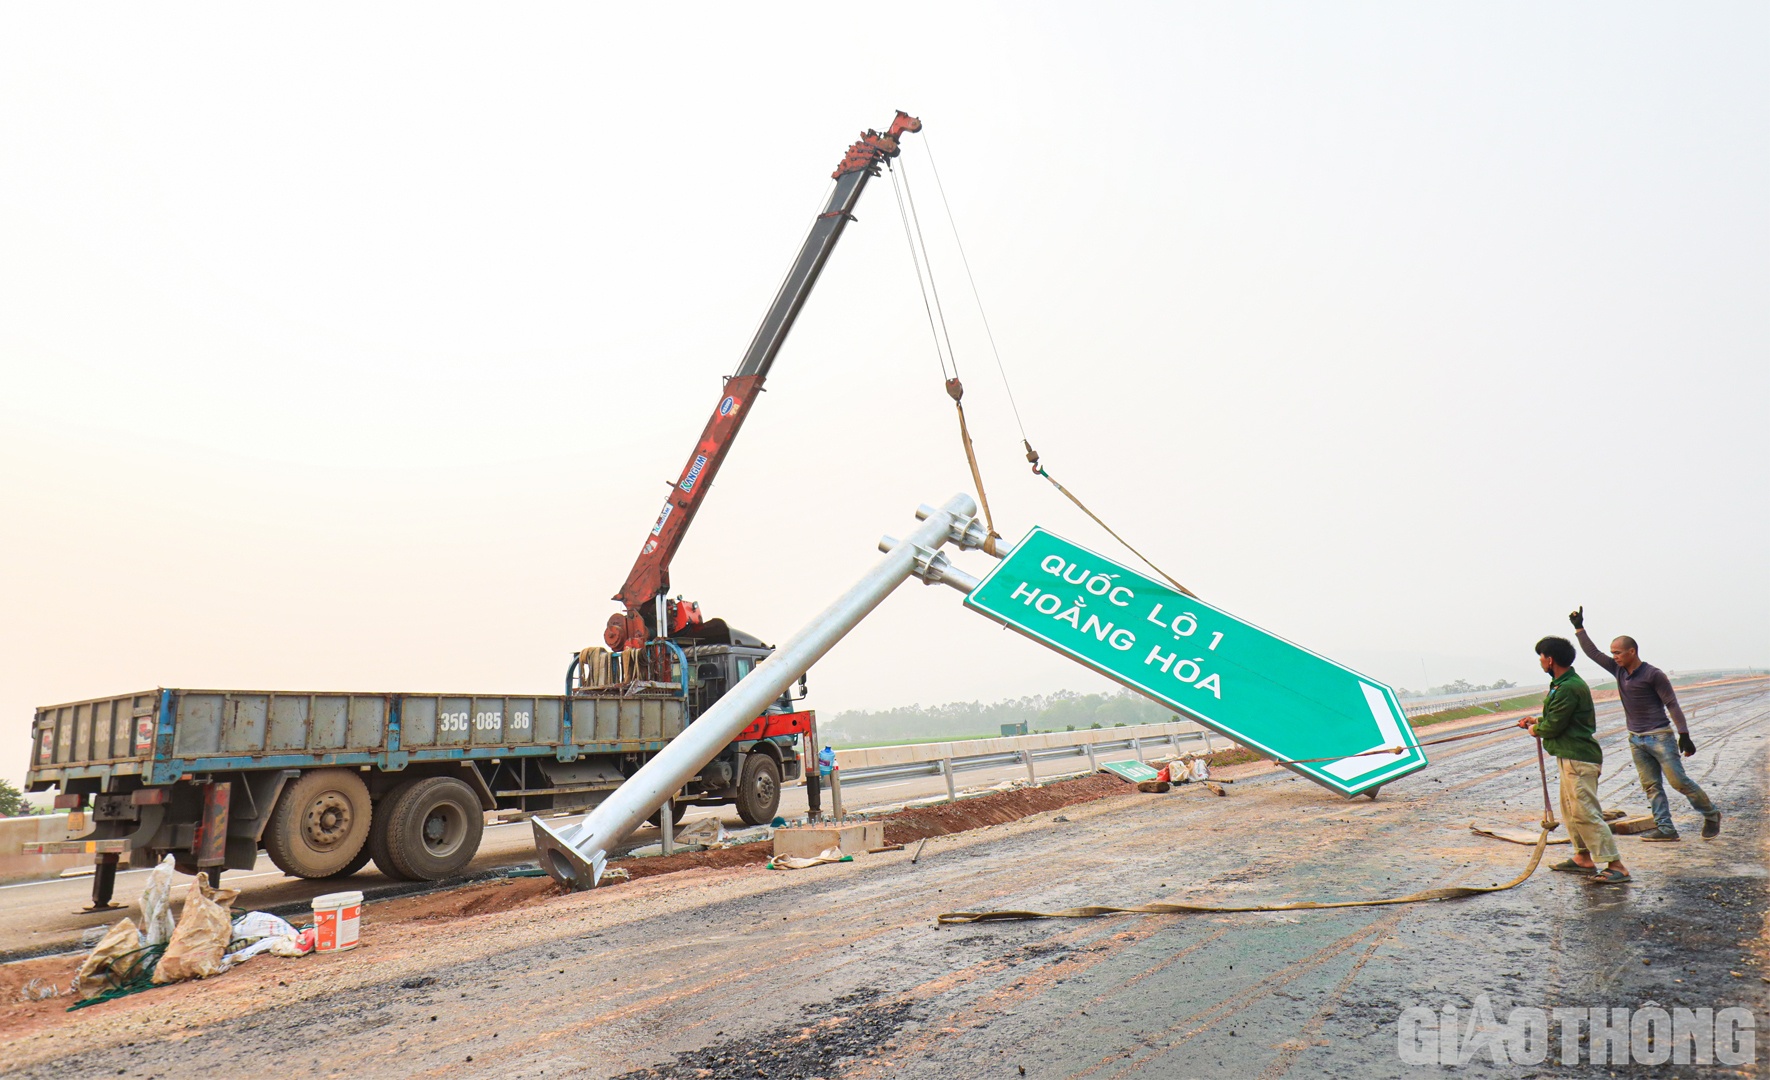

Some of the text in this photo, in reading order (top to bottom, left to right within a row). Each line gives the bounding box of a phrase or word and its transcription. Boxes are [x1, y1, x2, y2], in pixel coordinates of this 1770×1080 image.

[680, 455, 707, 492] KANGLIM
[1041, 554, 1224, 651] QUỐC LỘ 1
[1010, 581, 1221, 700] HOẰNG HÓA
[440, 712, 468, 732] 35C
